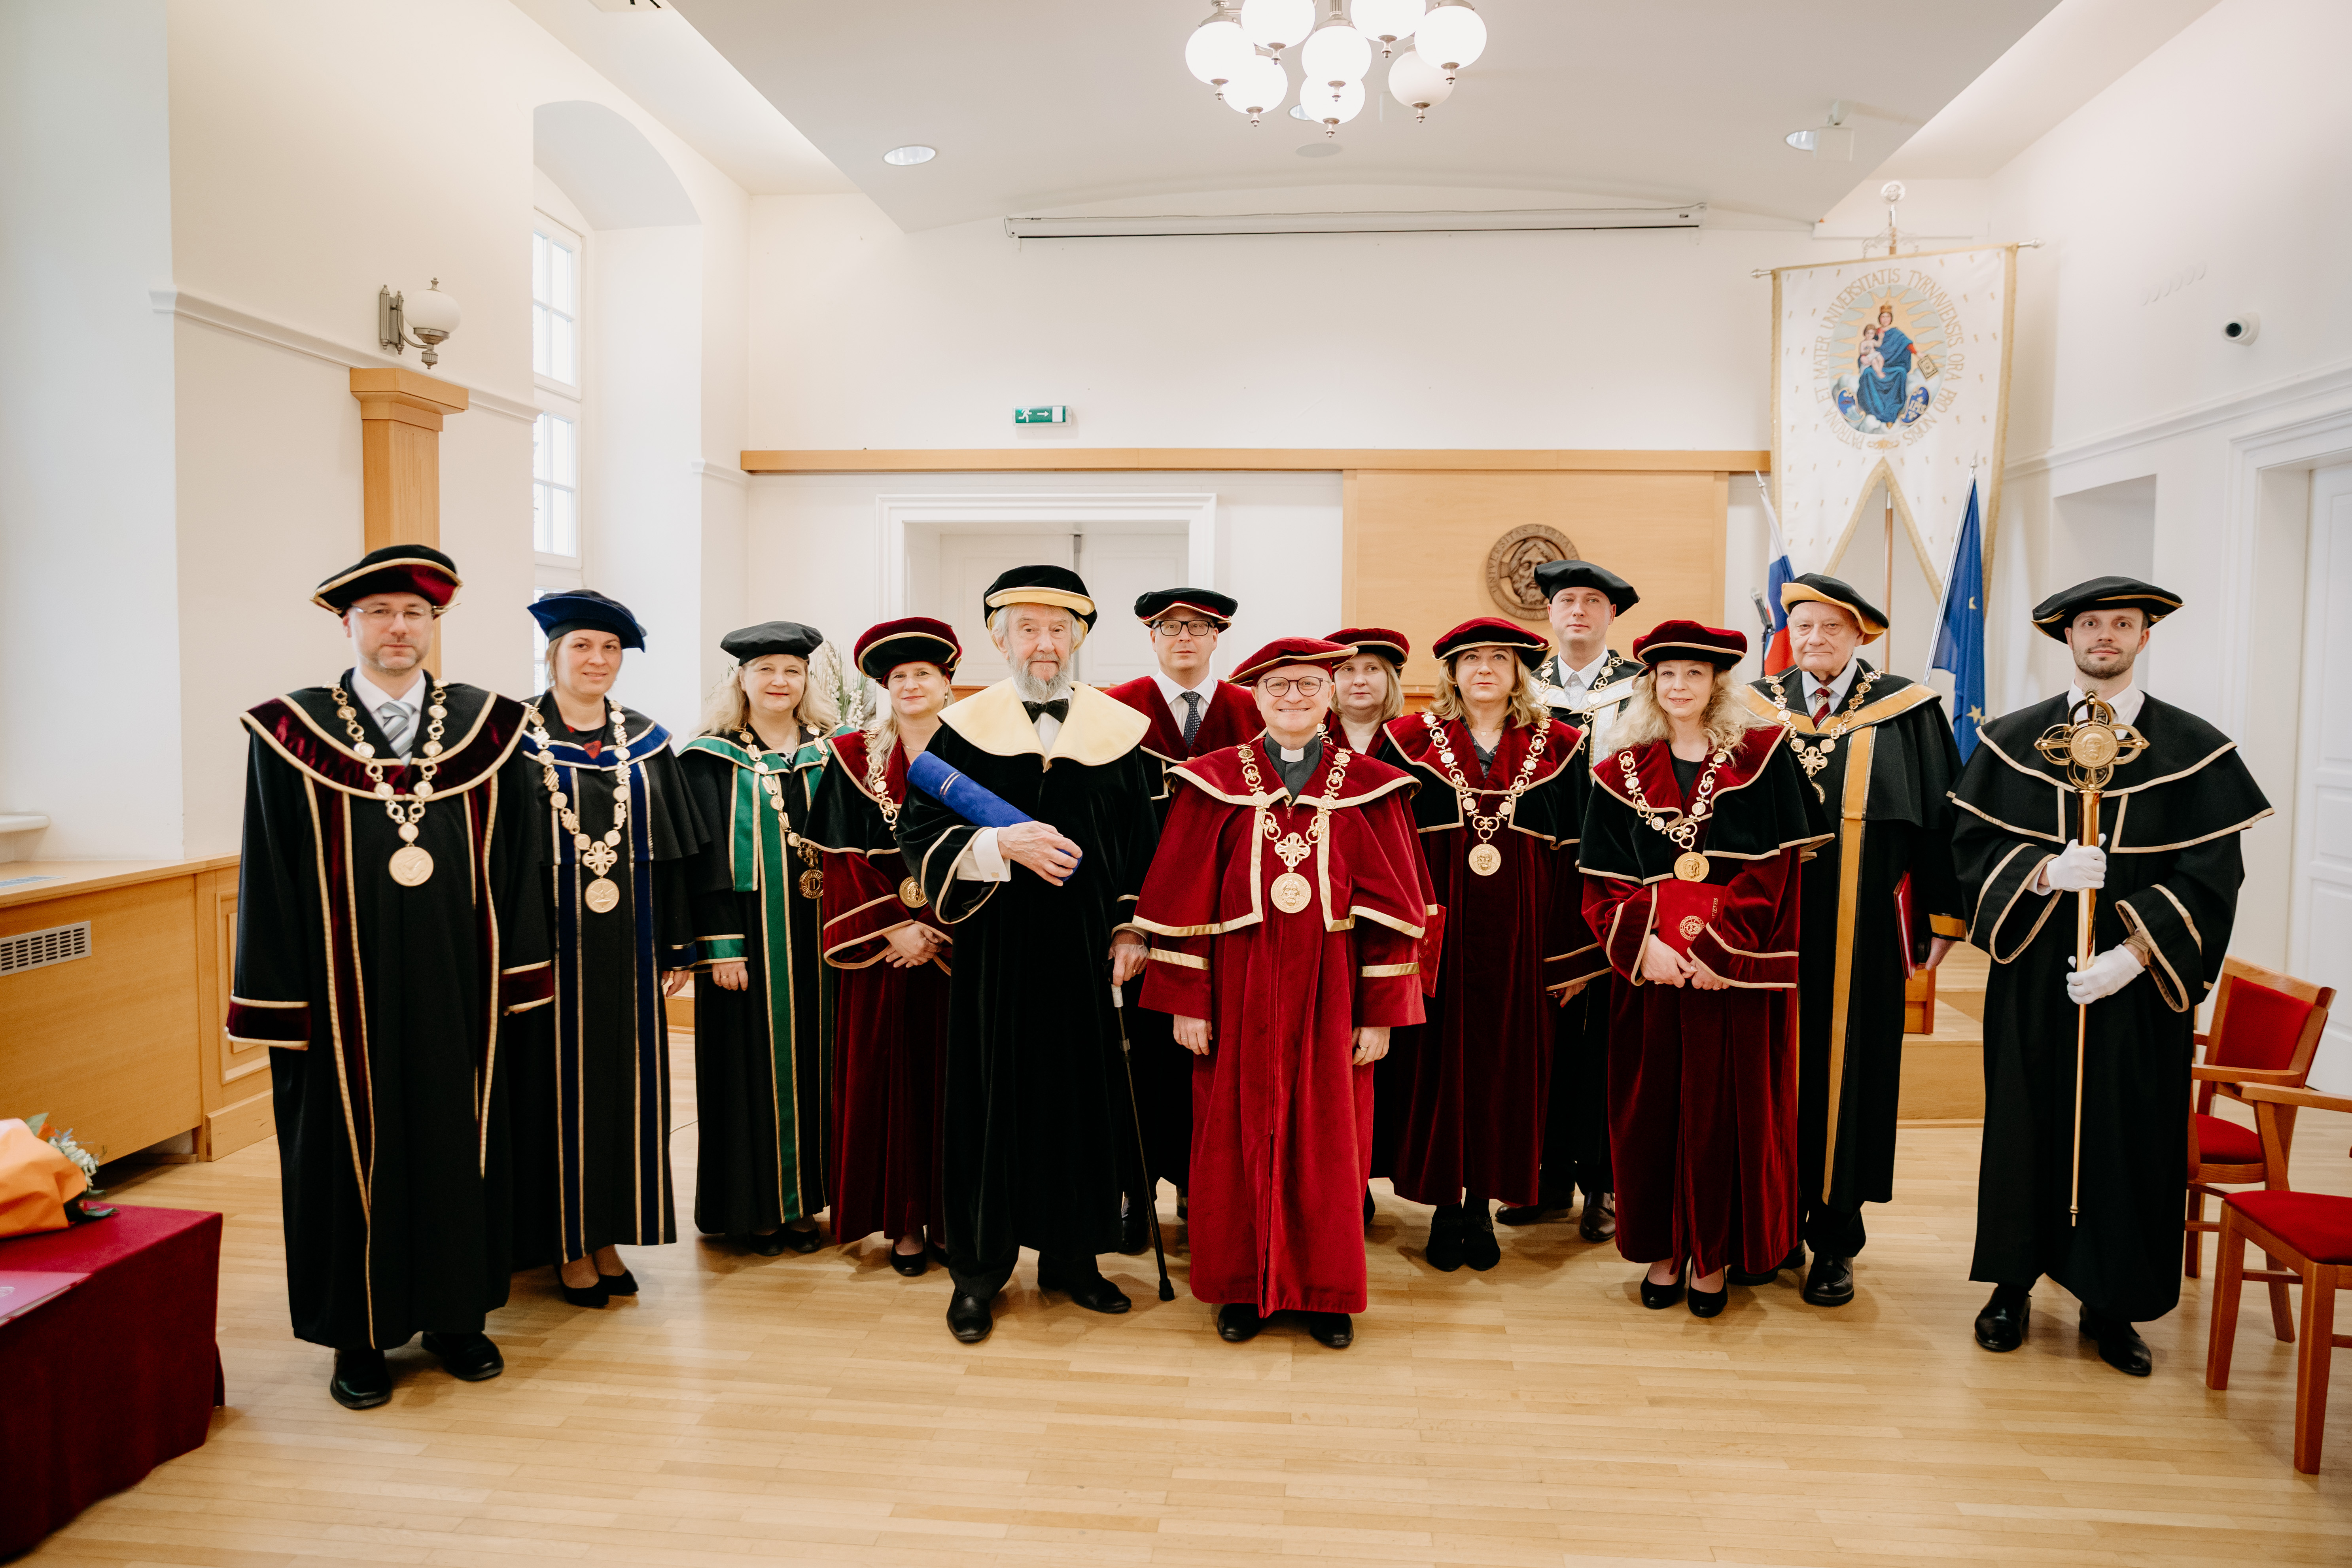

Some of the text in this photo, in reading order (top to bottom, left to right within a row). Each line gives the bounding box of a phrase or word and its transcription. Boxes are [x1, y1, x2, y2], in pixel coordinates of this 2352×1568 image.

[1813, 268, 1965, 450] PATRONA ET MATER UNIVERSITATIS TYRNAVIENSIS ORA PRO NOBIS
[1487, 528, 1527, 593] UNIVERSITAS
